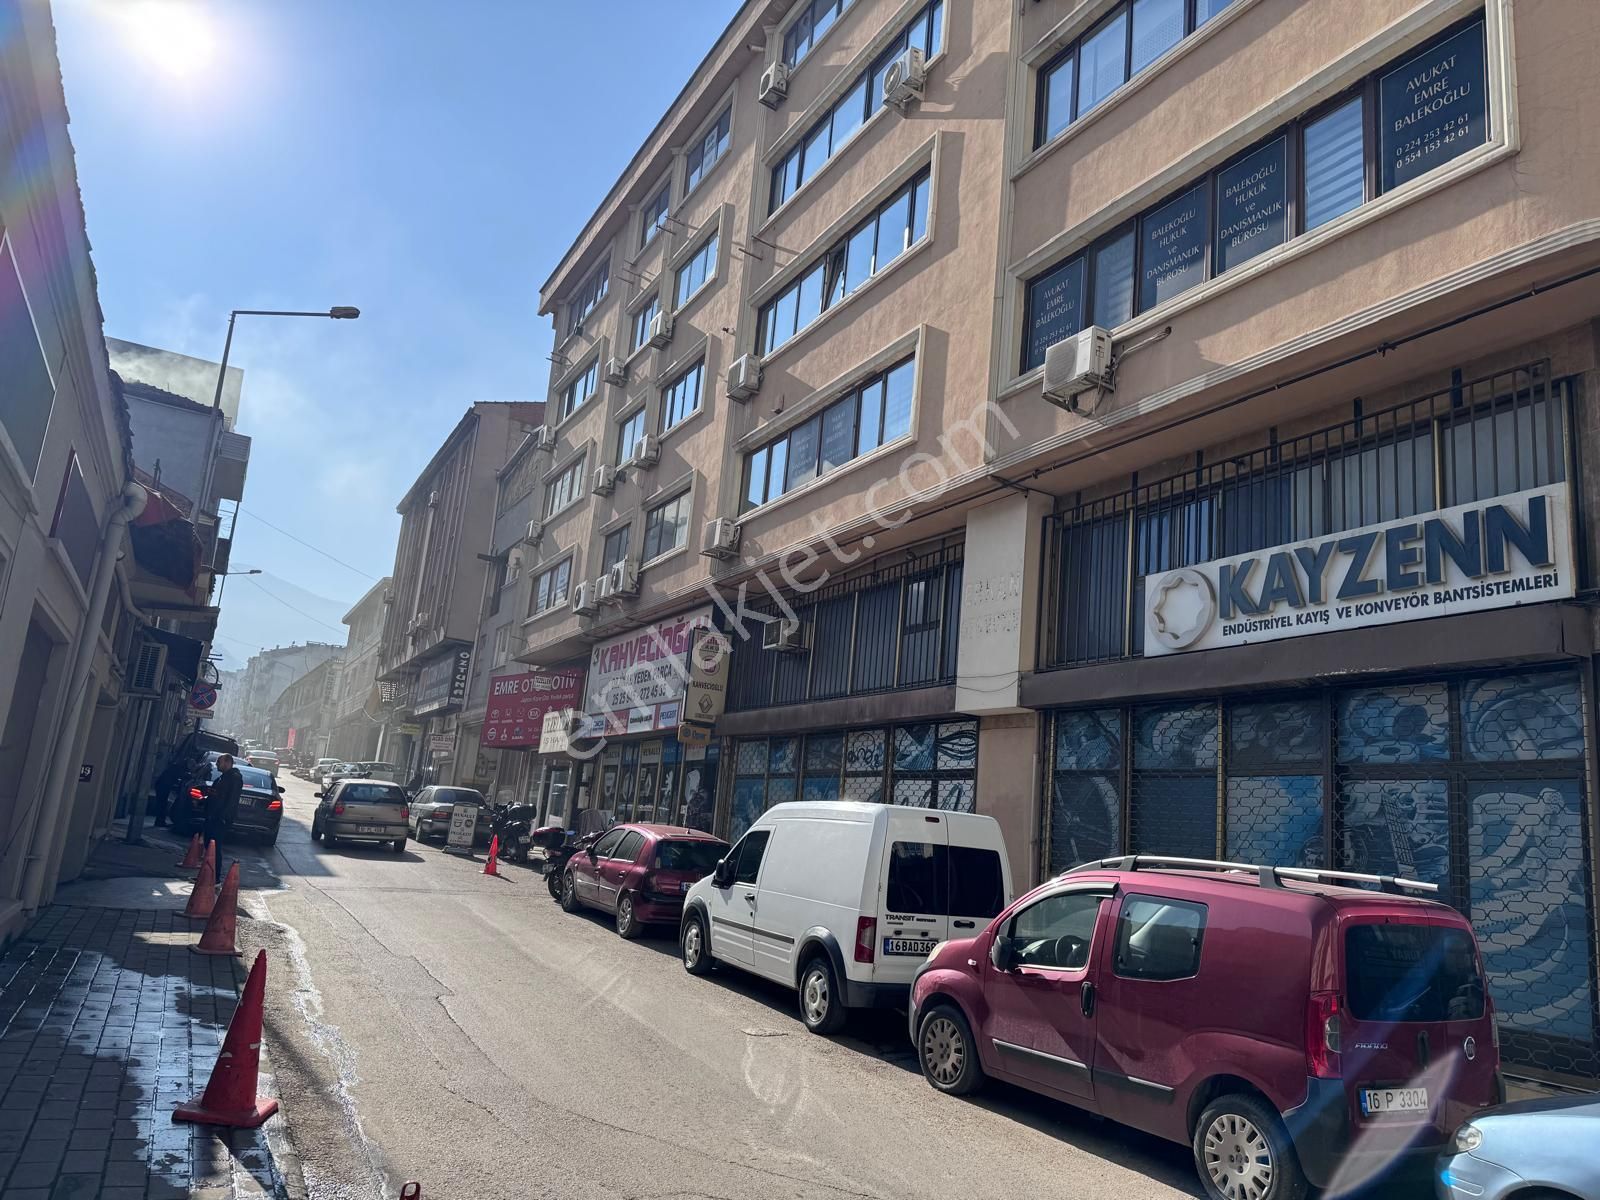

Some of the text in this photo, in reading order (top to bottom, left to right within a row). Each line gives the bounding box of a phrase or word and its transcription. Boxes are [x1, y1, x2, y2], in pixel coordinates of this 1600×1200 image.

[1406, 55, 1457, 93] AVUKAT
[1414, 76, 1449, 105] EMRE
[1394, 82, 1471, 132] BALEKOĞLU
[1404, 137, 1421, 152] 224
[1424, 128, 1440, 142] 253
[1443, 120, 1455, 131] 42
[1458, 112, 1469, 124] 61
[1405, 150, 1421, 165] 554
[1425, 140, 1440, 154] 153
[1443, 133, 1455, 144] 42
[1458, 125, 1469, 137] 61
[1225, 162, 1277, 198] BALEKOĞLU
[1235, 182, 1267, 205] HUKUK
[1245, 202, 1256, 213] ve
[1159, 225, 1187, 248] HUKUK
[1231, 219, 1269, 247] BÜROSU
[1218, 495, 1554, 620] KAYZENN
[1221, 614, 1293, 637] ENDÜSTRİYEL
[1295, 610, 1331, 626] KAYIŞ
[1335, 605, 1352, 620] VE
[1355, 591, 1429, 617] KONVEYÖR
[494, 680, 520, 696] EMRE
[1367, 1090, 1427, 1109] 16 P 3304
